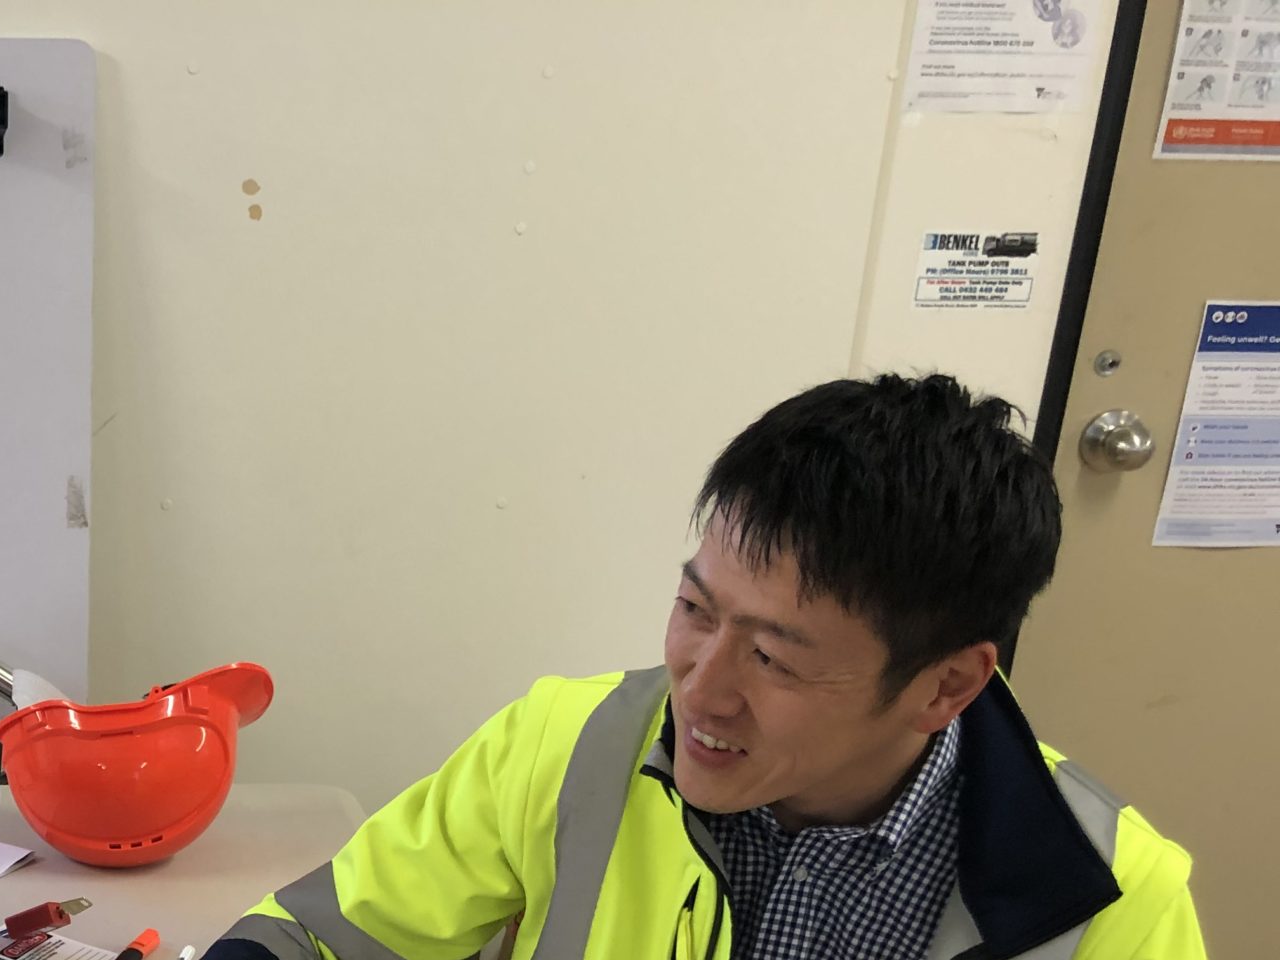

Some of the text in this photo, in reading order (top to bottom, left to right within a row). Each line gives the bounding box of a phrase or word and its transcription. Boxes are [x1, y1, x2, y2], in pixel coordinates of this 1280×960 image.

[939, 233, 980, 250] BENKEL
[1207, 335, 1236, 344] Feeling
[1237, 335, 1269, 343] unwell?
